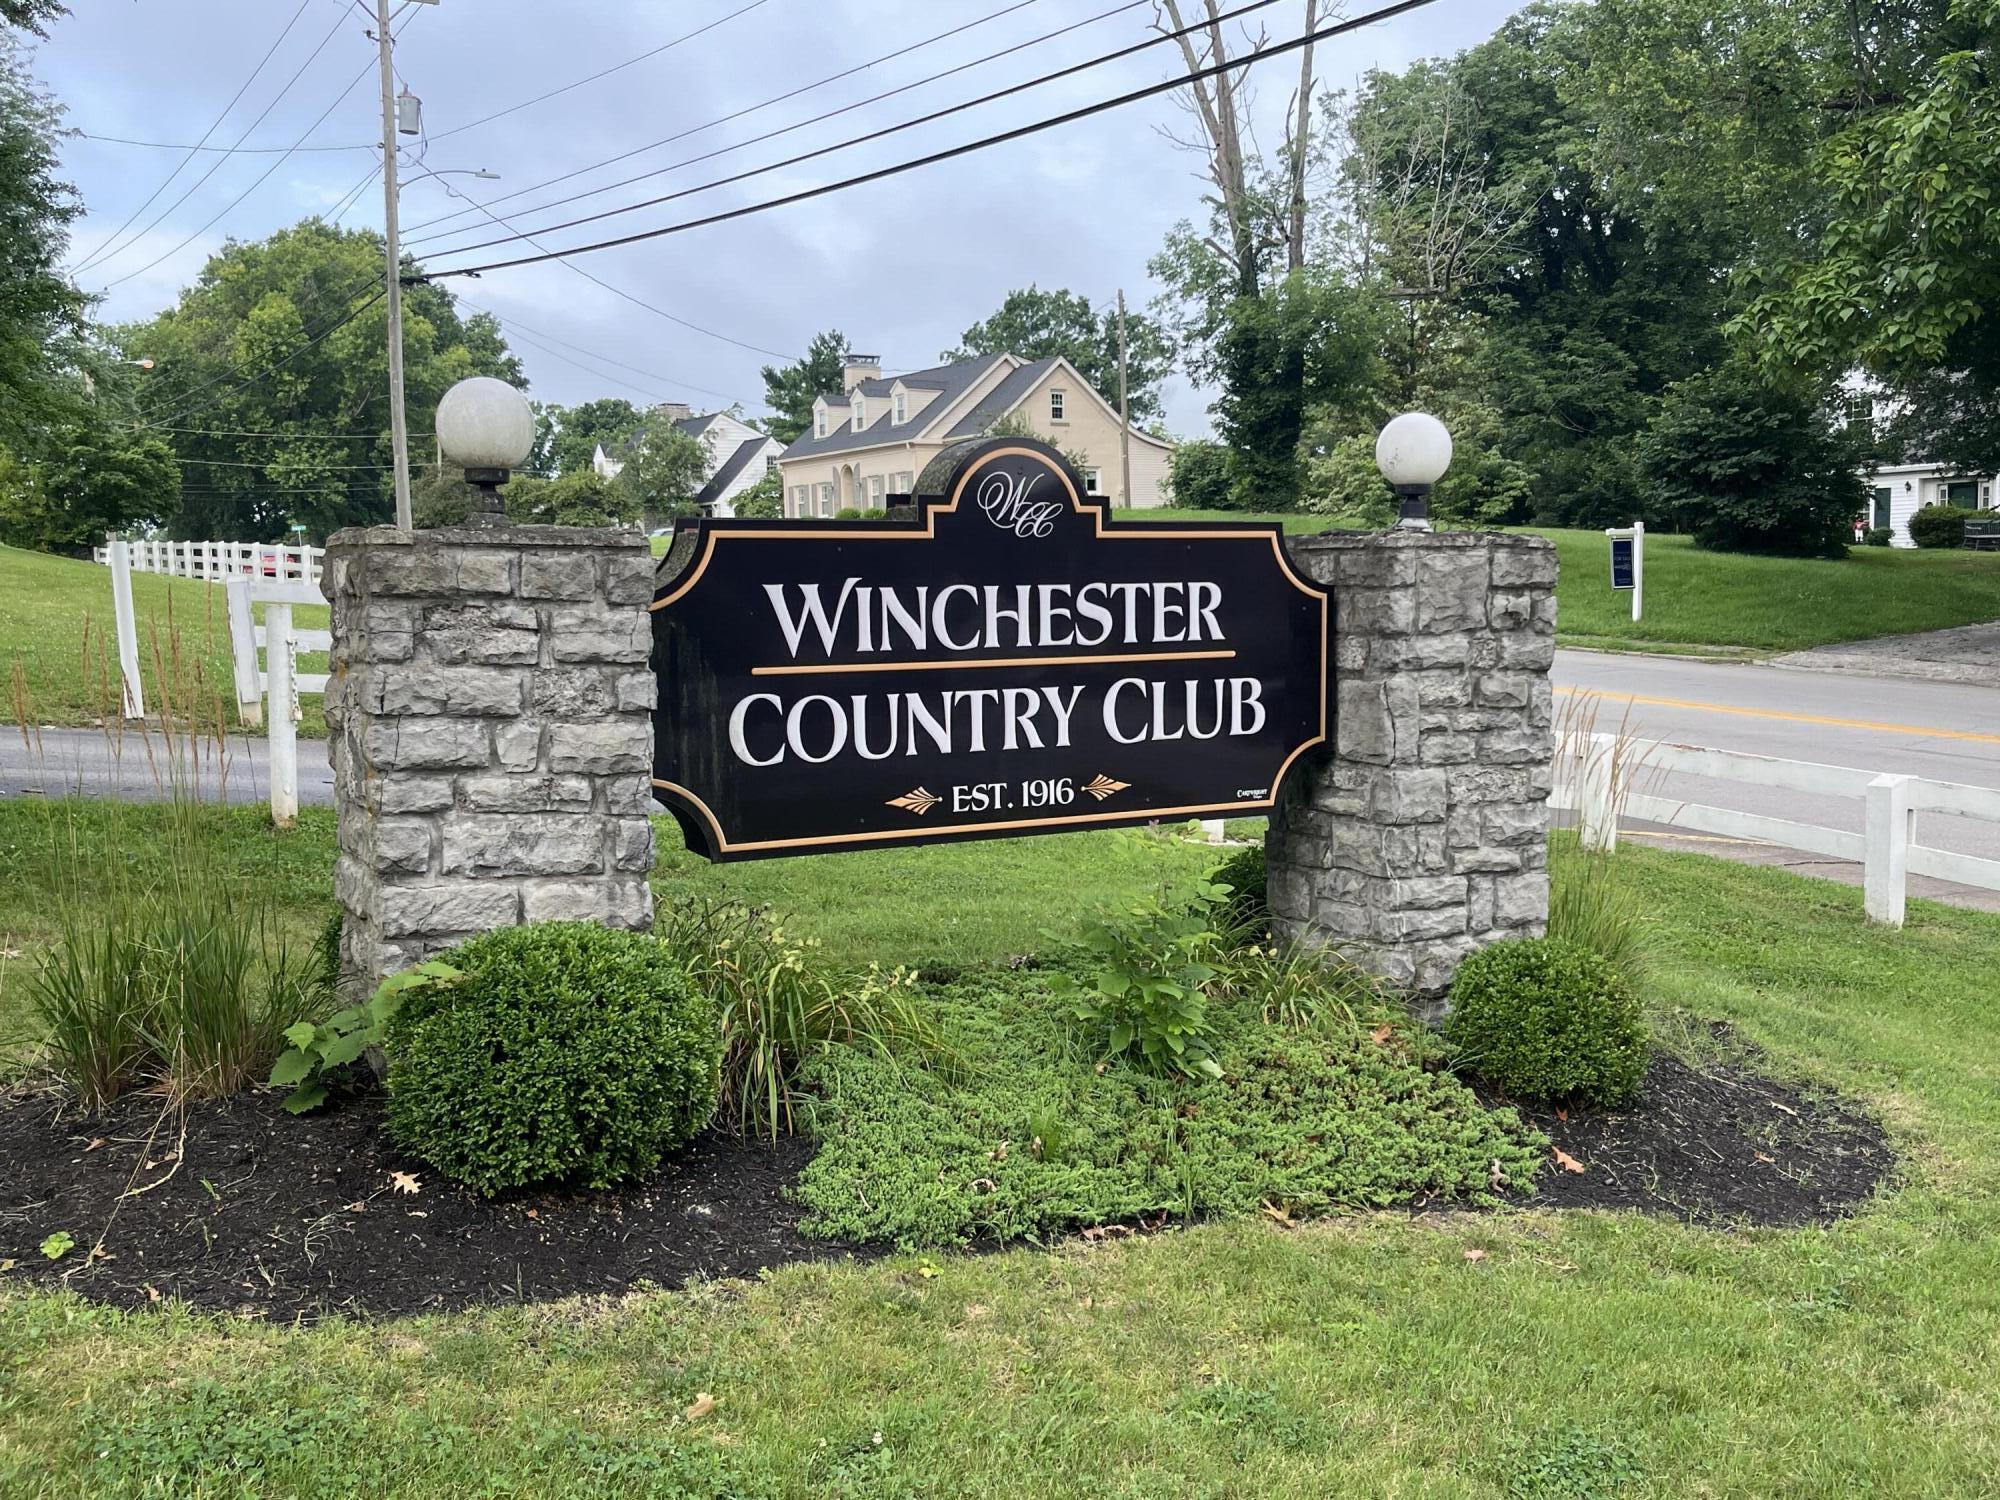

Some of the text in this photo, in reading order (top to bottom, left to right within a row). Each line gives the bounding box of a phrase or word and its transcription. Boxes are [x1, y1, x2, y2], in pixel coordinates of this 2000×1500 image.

[763, 578, 1225, 658] WINCHESTER
[729, 678, 1266, 766] COUNTRY CLUB
[952, 778, 1075, 813] EST. 1916
